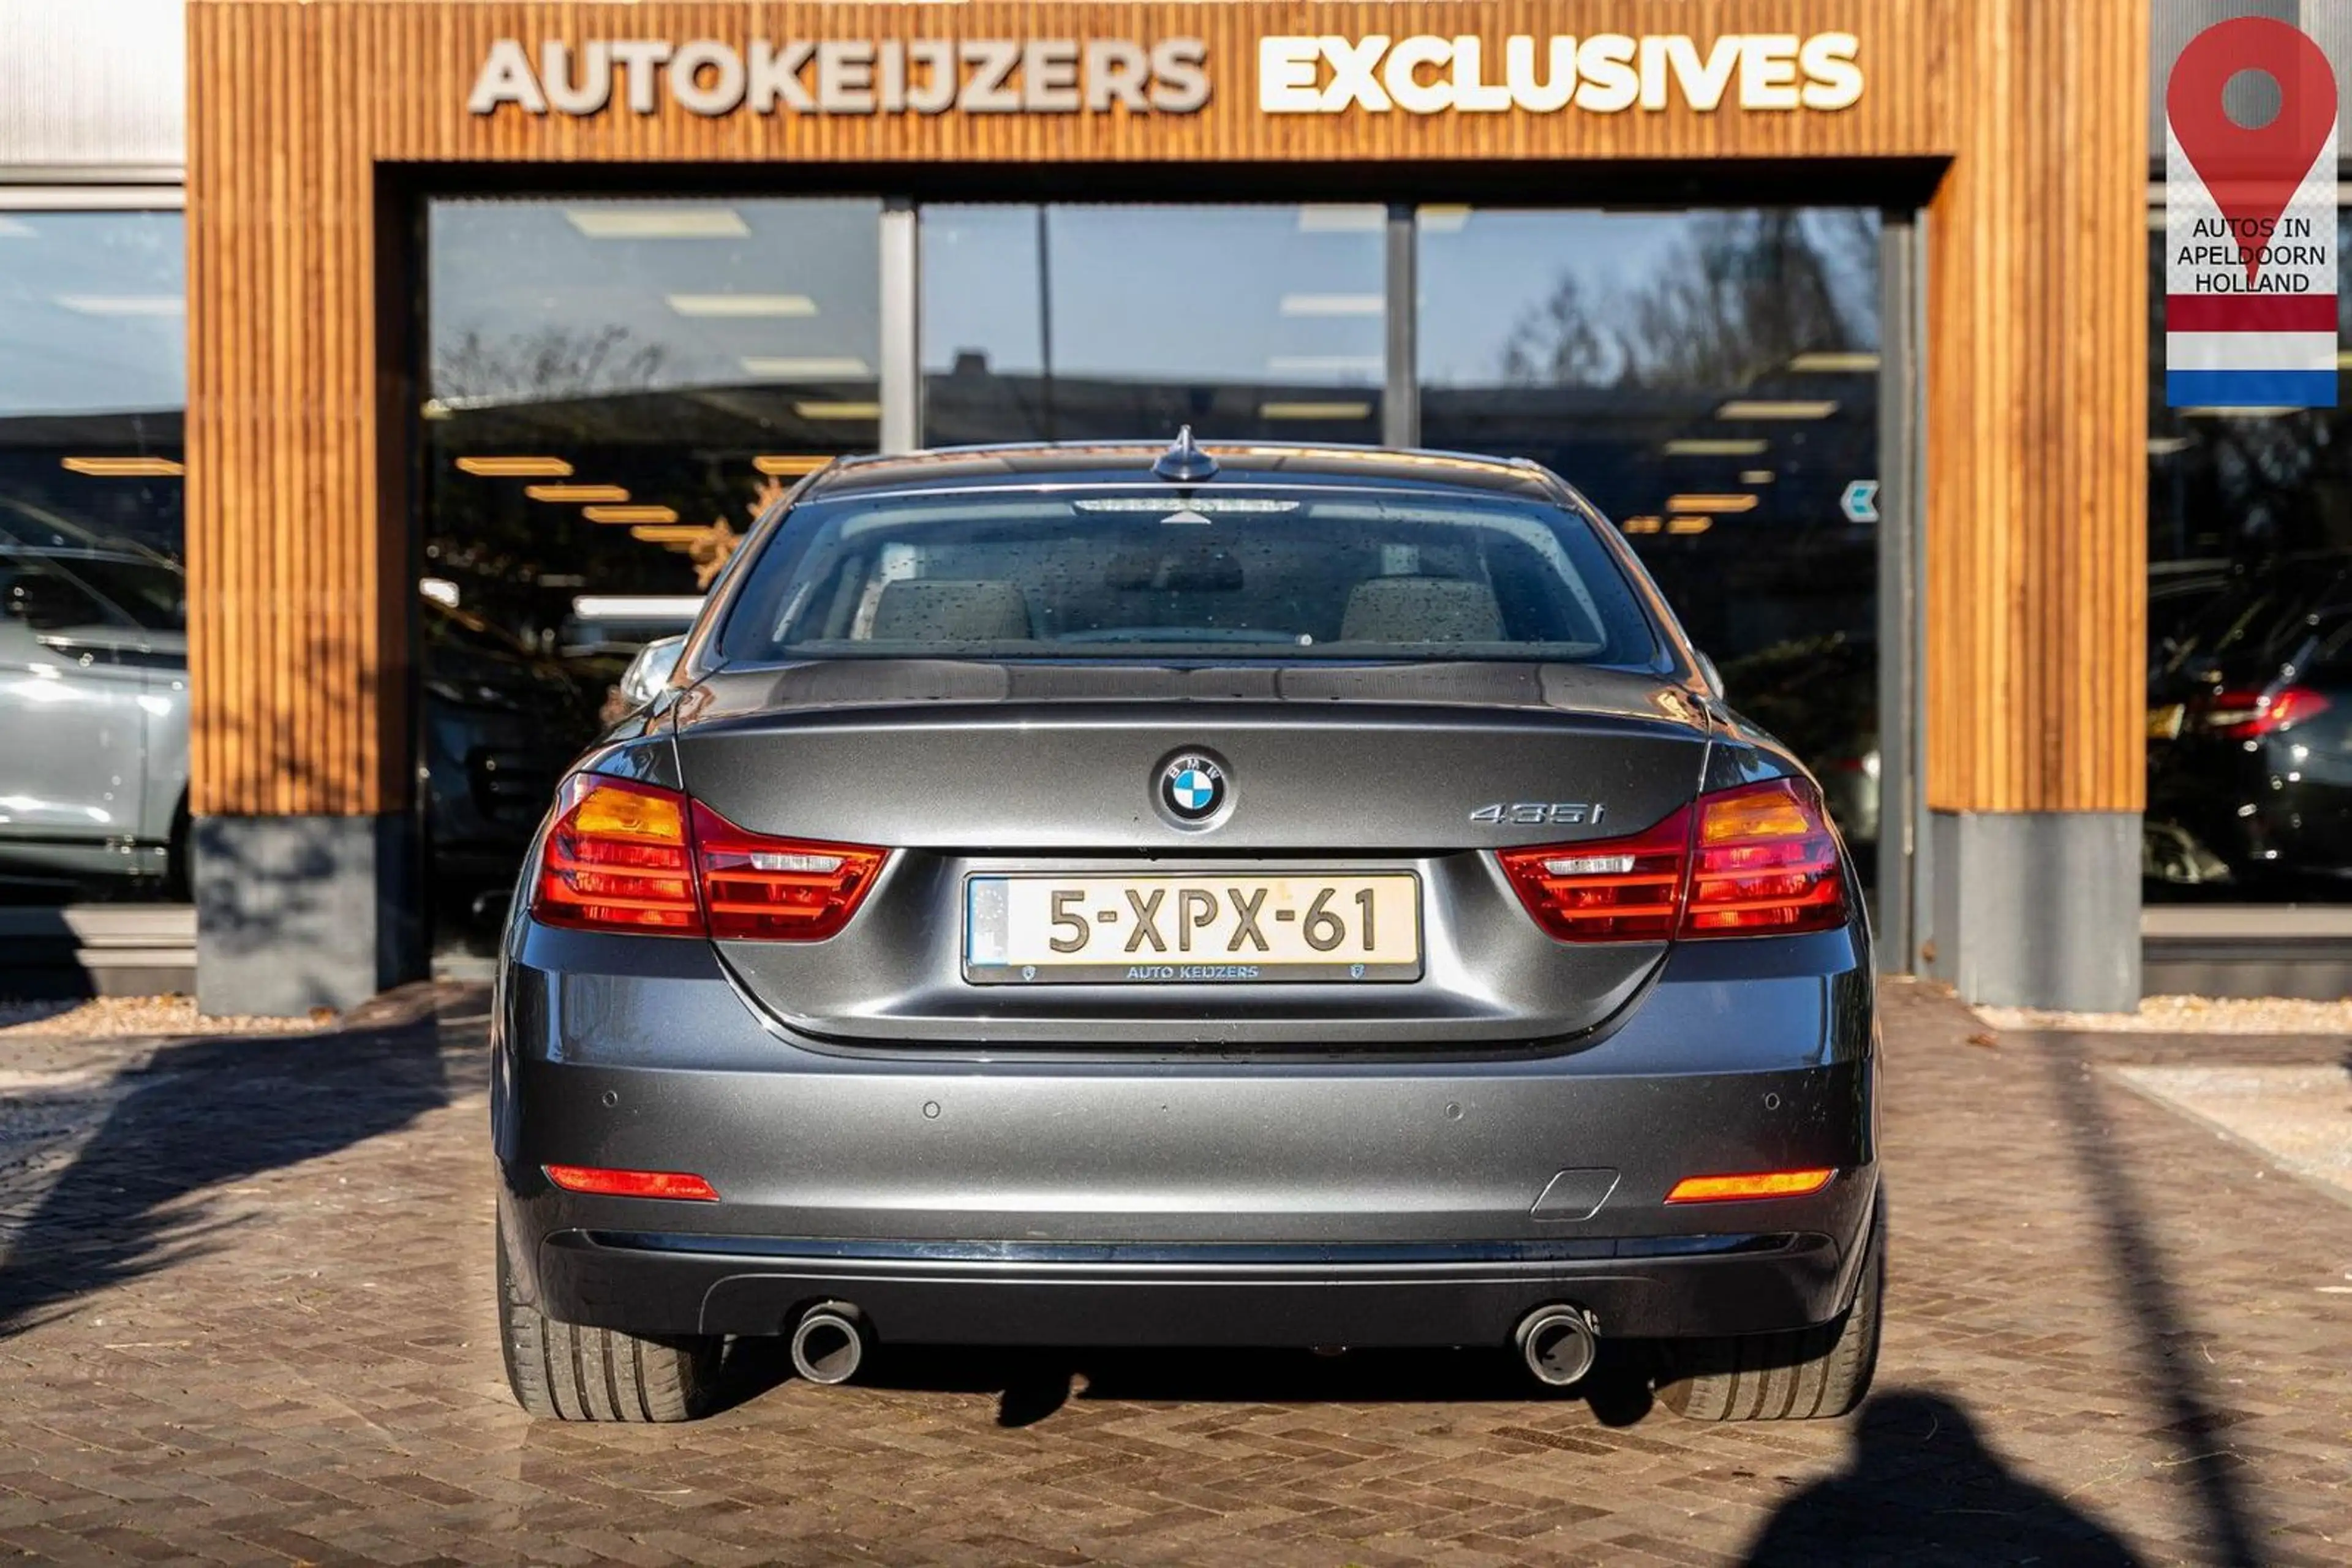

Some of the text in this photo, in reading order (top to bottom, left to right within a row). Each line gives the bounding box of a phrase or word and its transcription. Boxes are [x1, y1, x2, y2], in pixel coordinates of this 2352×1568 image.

[467, 32, 1863, 116] AUTOKEIJZERS EXCLUSIVES
[1168, 758, 1220, 780] BMW
[1049, 888, 1375, 952] 5-XPX-61
[1126, 965, 1259, 979] AUTO KEIJZERS
